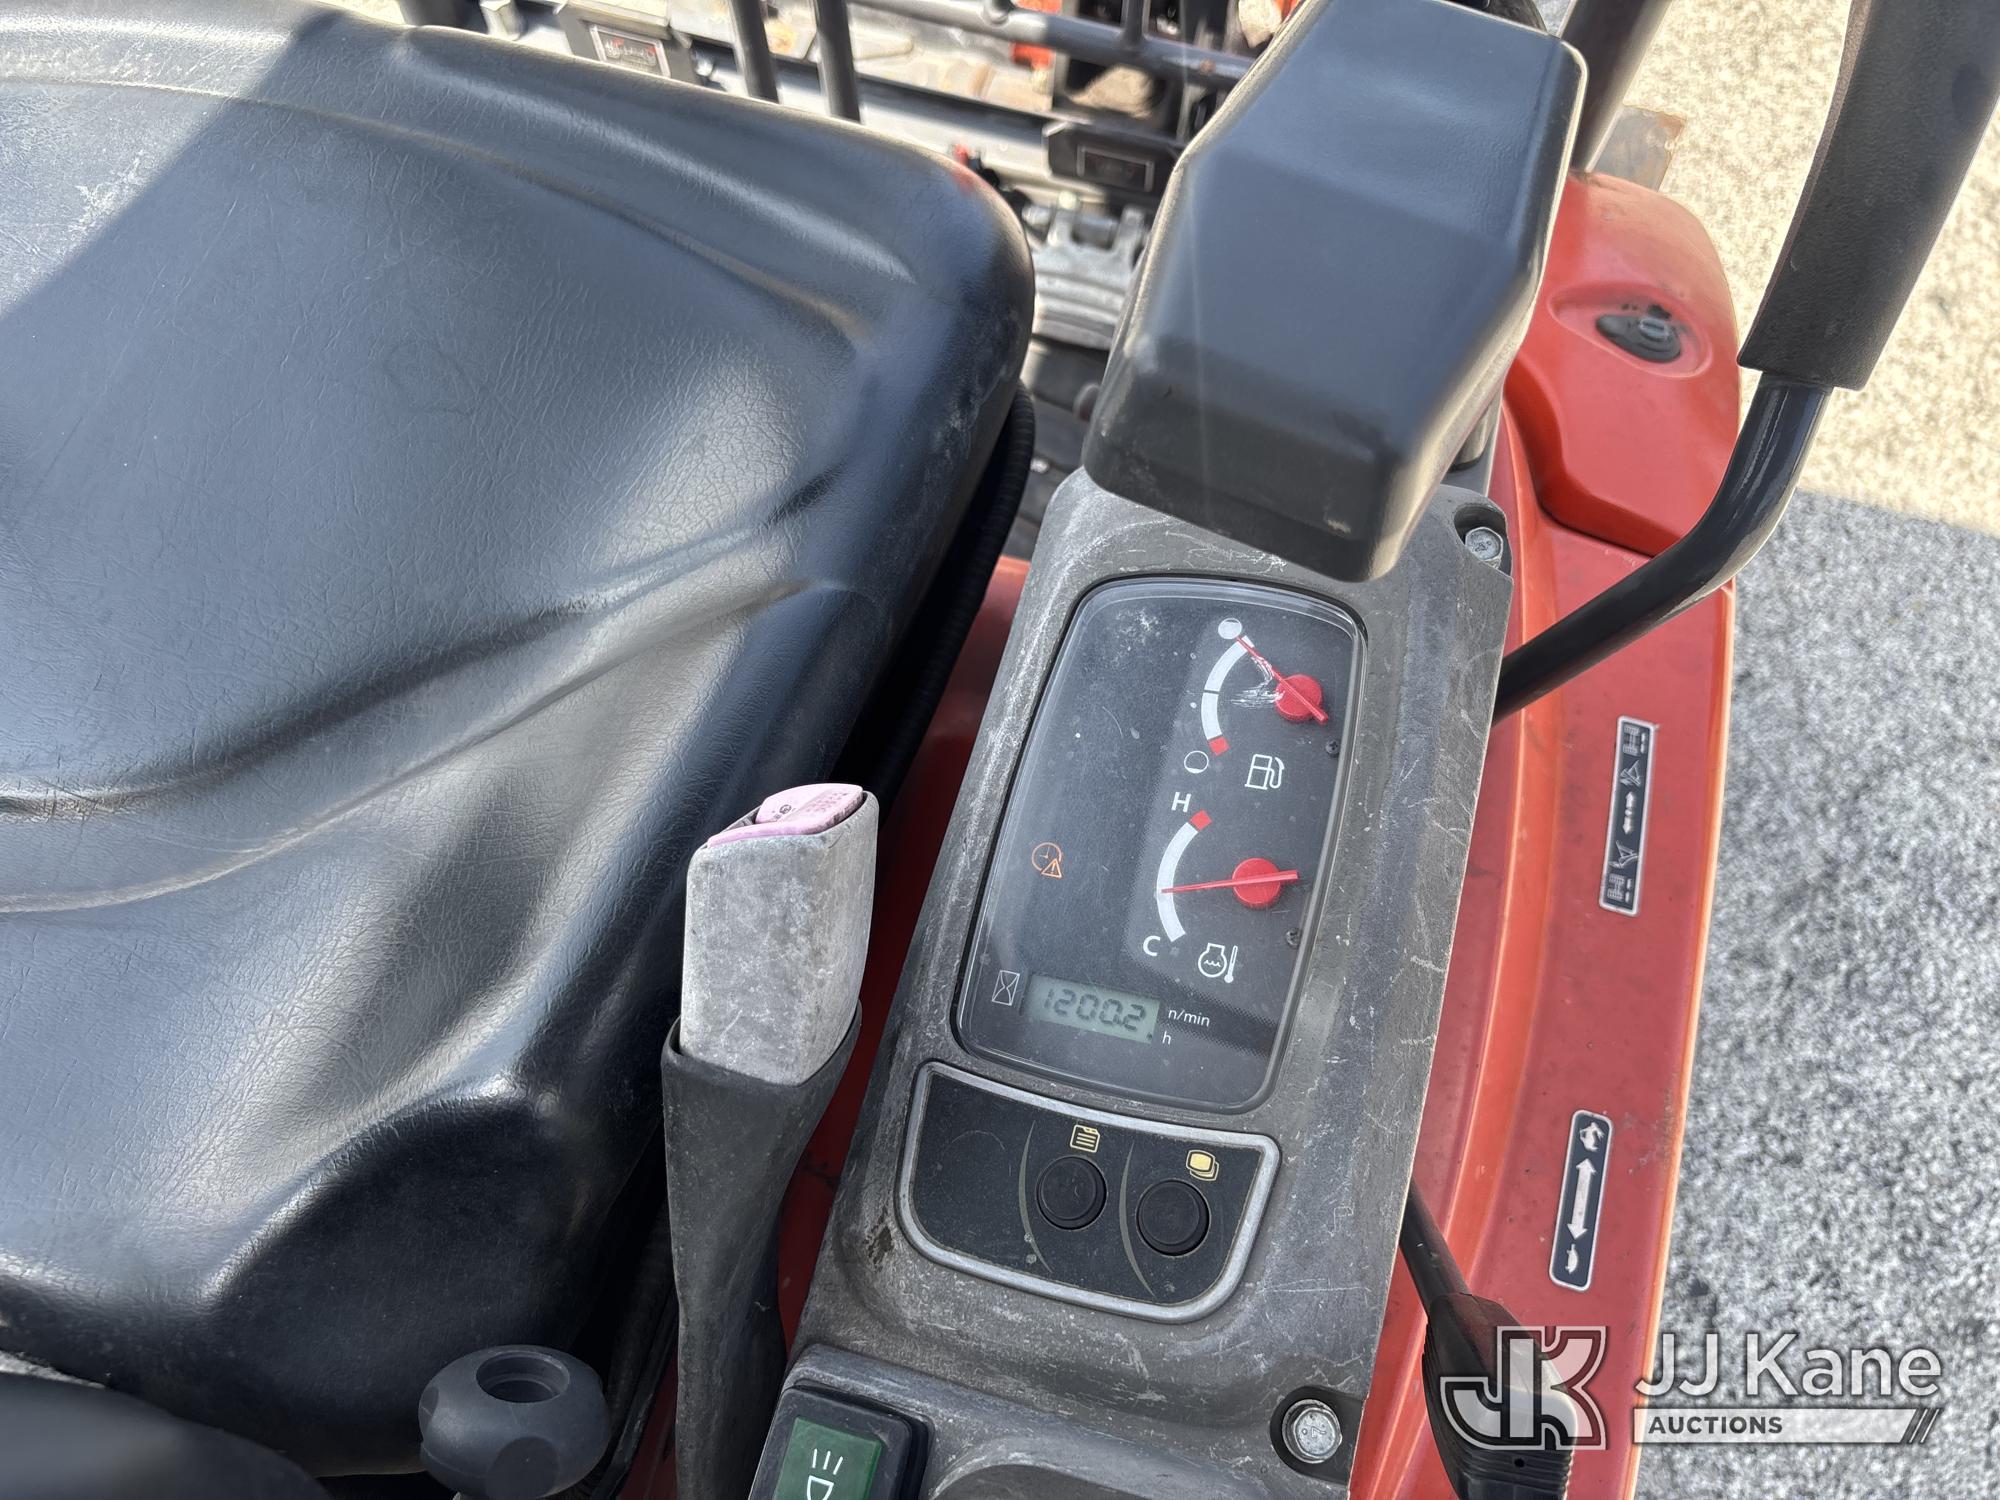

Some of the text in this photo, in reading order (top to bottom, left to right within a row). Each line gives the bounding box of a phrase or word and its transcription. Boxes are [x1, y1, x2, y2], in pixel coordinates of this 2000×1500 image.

[1171, 791, 1192, 813] H
[1143, 935, 1161, 957] C
[1167, 1008, 1210, 1027] n/min
[1162, 1030, 1171, 1045] h
